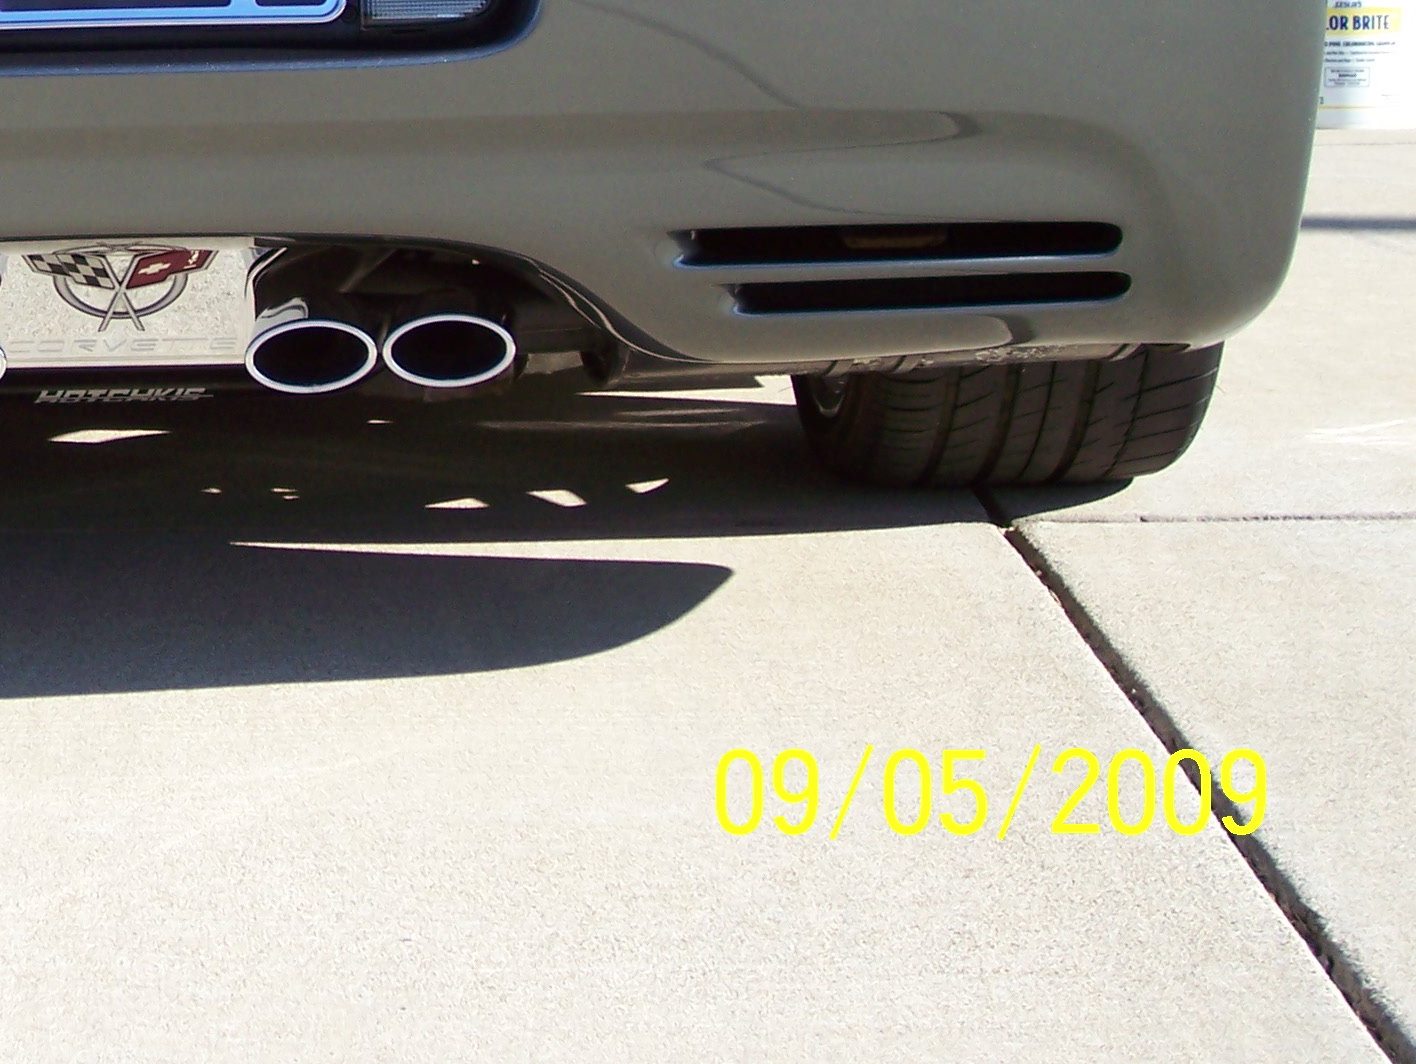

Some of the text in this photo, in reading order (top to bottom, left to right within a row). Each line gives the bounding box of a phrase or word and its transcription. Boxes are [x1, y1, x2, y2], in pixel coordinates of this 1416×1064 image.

[1352, 14, 1390, 30] BRITE
[7, 337, 238, 354] CORVETTE
[33, 387, 214, 405] HOTCHKIS
